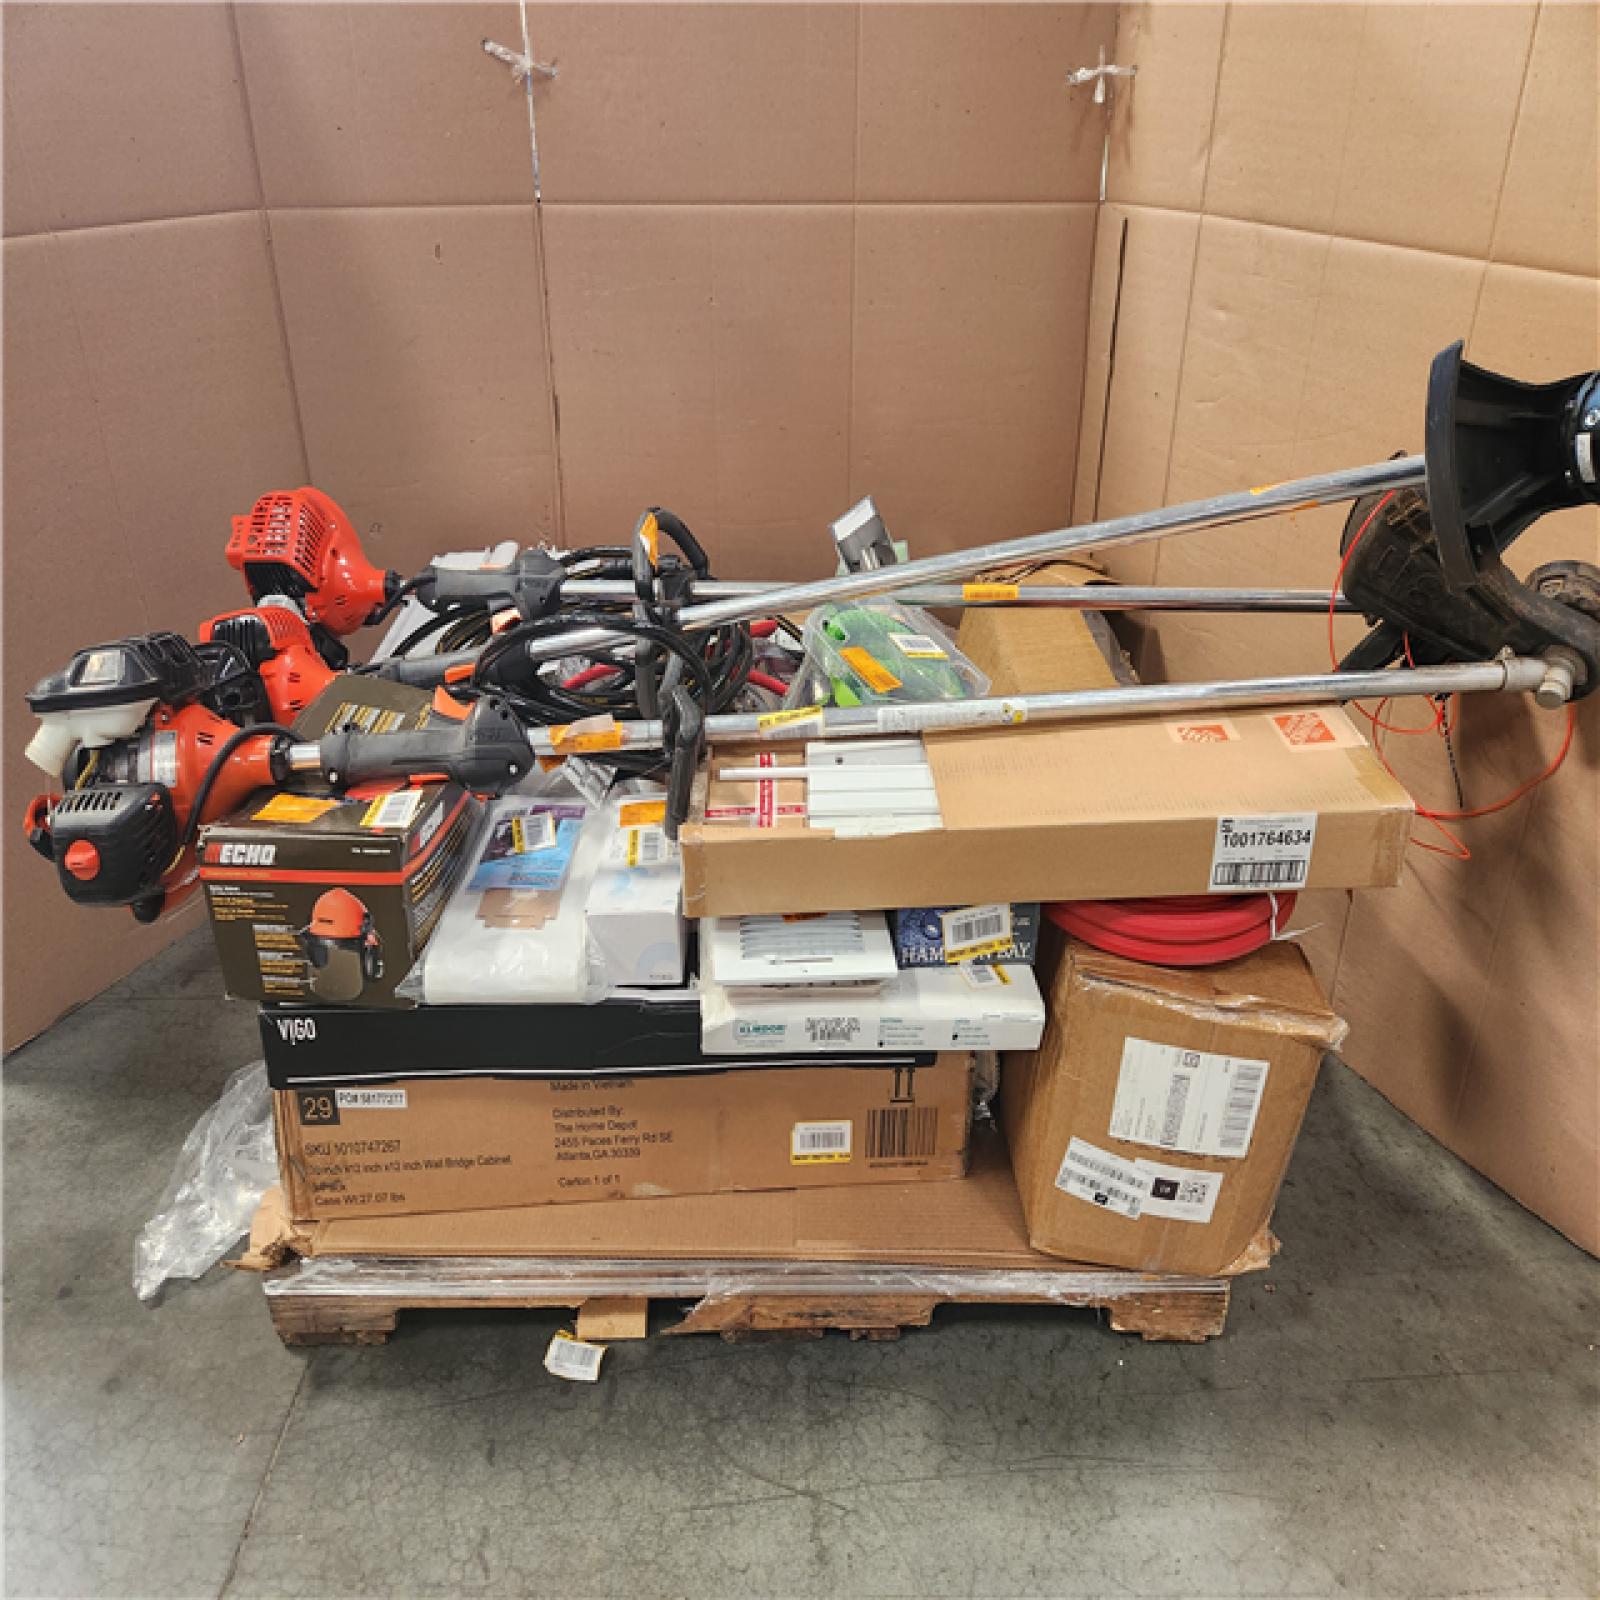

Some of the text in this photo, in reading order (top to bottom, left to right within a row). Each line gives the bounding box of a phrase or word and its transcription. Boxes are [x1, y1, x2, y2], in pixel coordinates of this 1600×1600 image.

[1223, 829, 1311, 849] 1001764634
[219, 844, 276, 866] ECHO
[277, 1017, 316, 1046] VIGO
[303, 1096, 334, 1120] 29
[552, 1106, 605, 1118] Distributed
[555, 1119, 638, 1132] The Home Depot
[581, 1135, 613, 1146] Paces
[614, 1134, 640, 1146] Ferry
[642, 1132, 658, 1143] Rd
[305, 1142, 331, 1156] SKU
[445, 1156, 476, 1170] Bridge
[477, 1153, 513, 1167] Cabinet
[558, 1176, 591, 1188] Carton
[315, 1193, 341, 1206] Case
